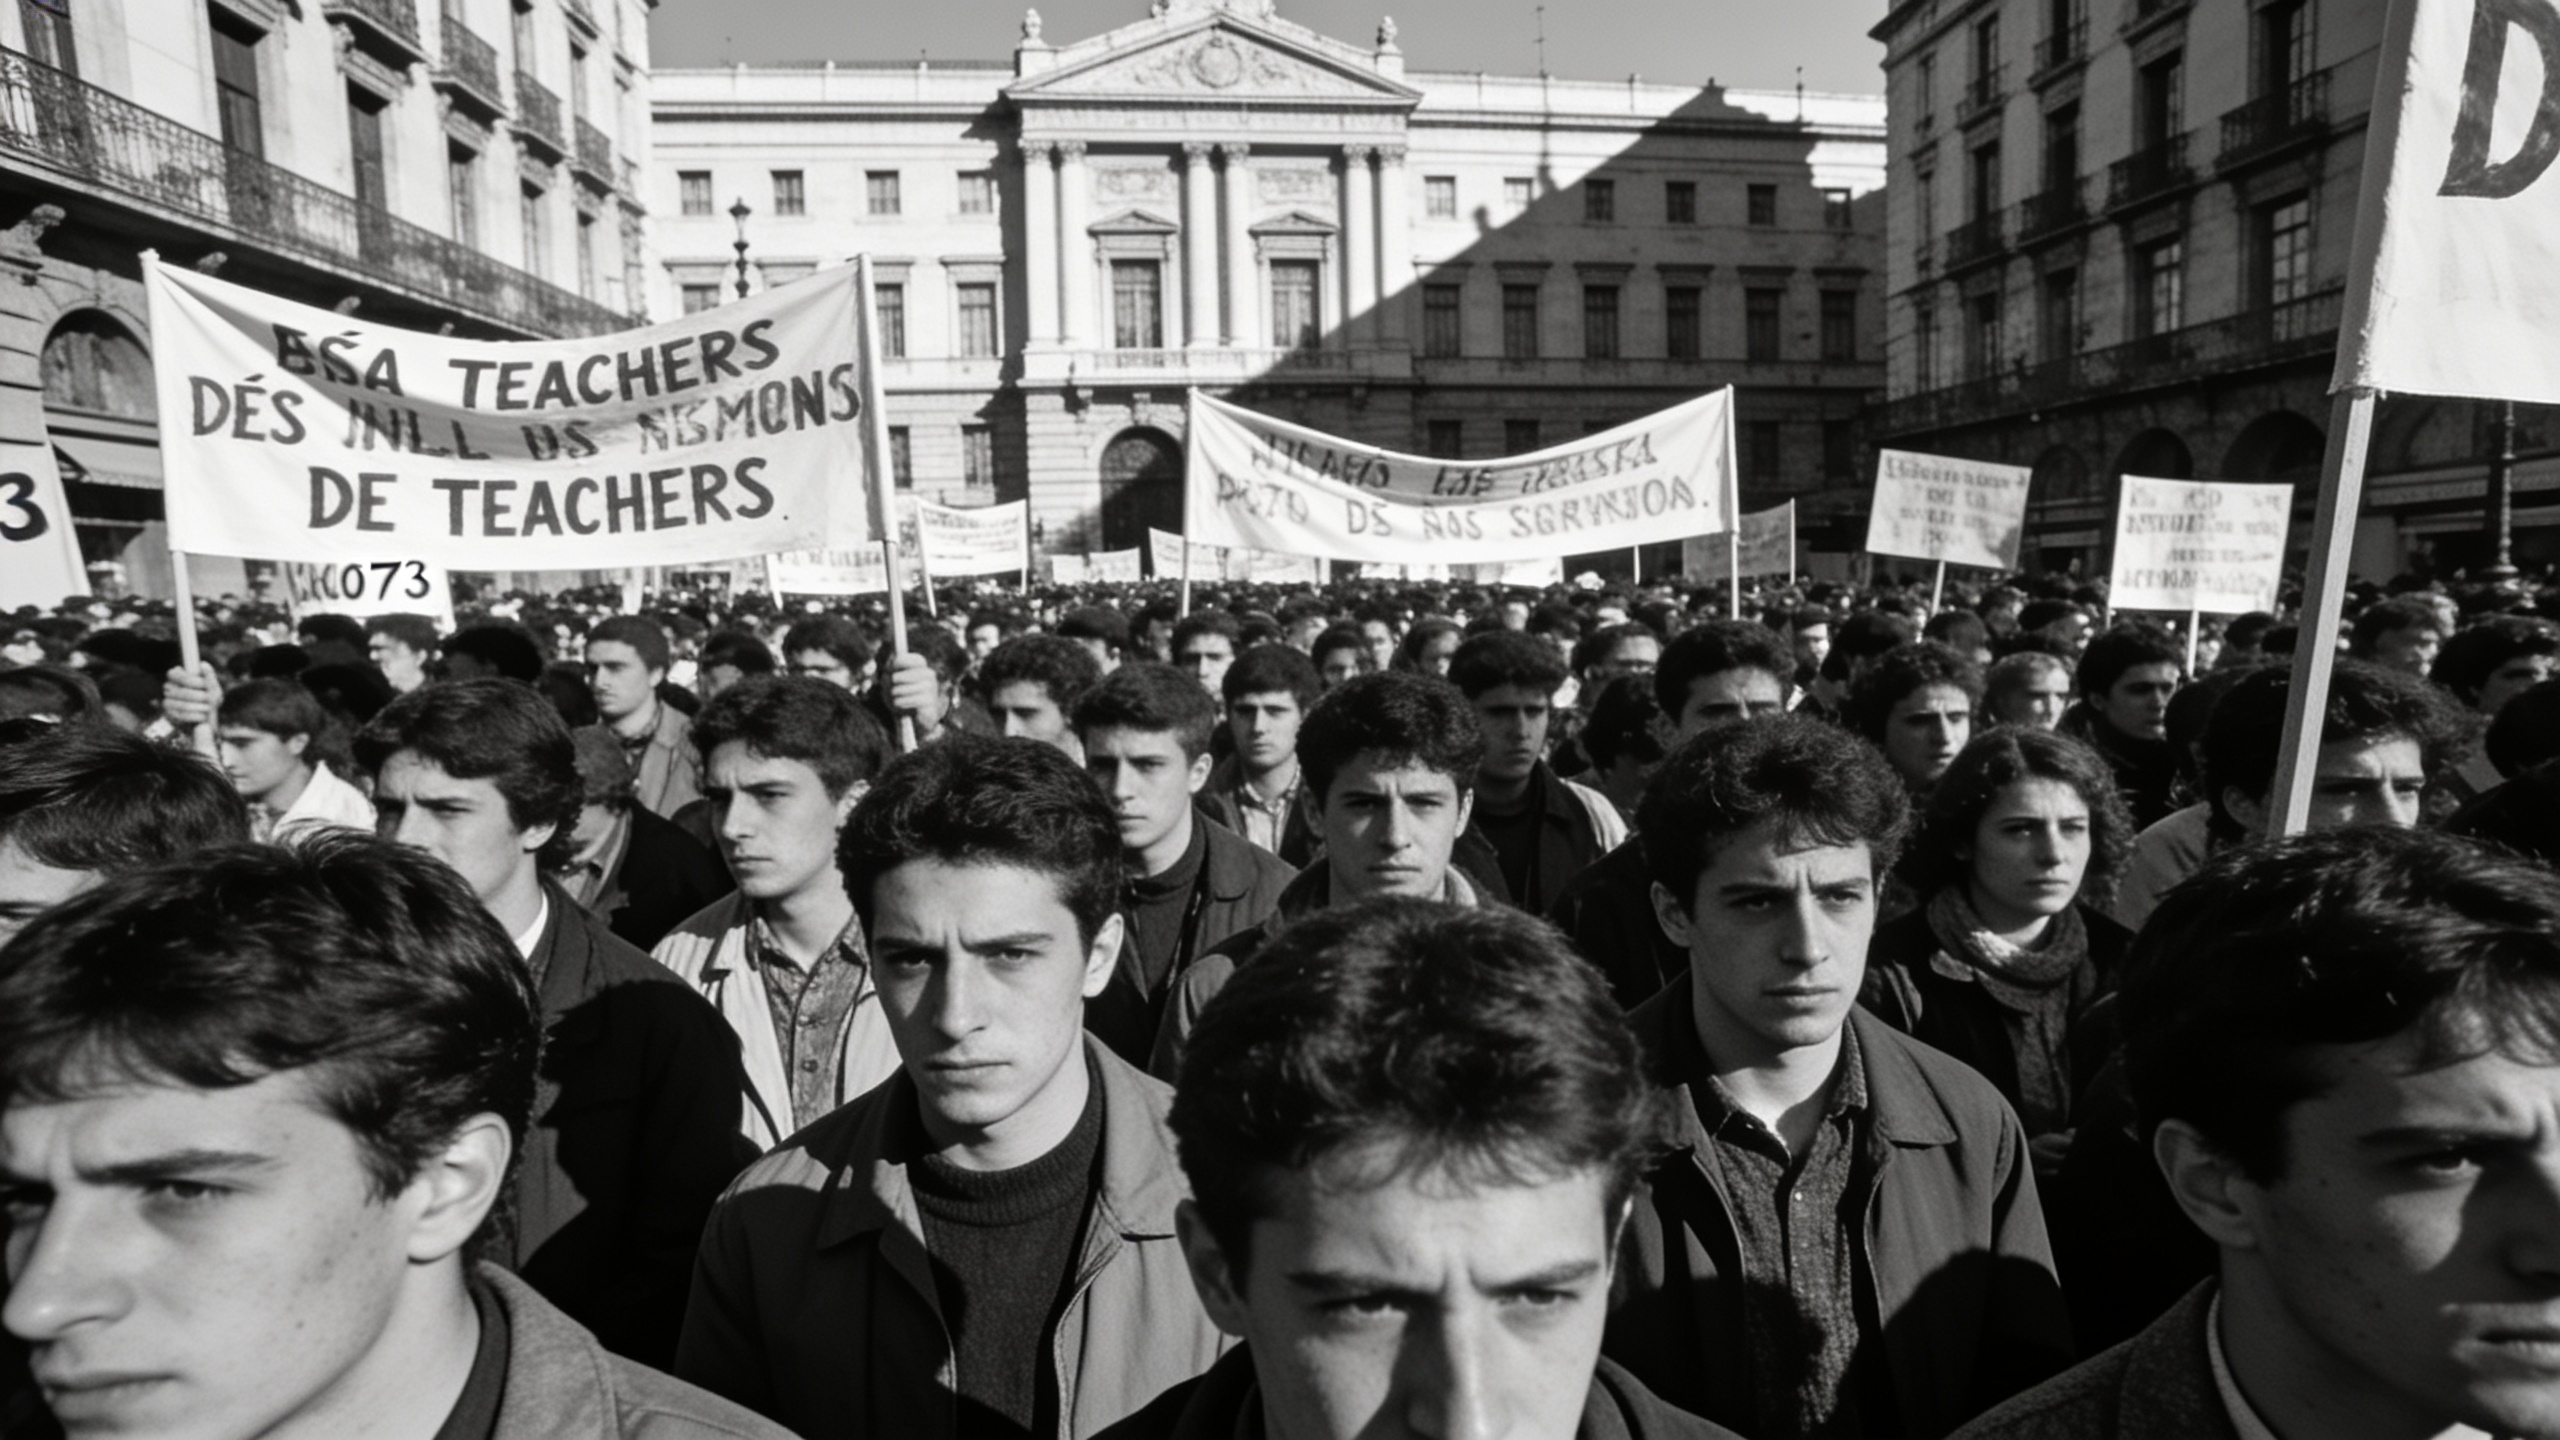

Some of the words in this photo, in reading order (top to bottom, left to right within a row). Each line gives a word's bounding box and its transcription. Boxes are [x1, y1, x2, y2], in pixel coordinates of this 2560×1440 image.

[448, 318, 780, 411] TEACHERS
[188, 373, 306, 445] DÉS
[0, 471, 49, 542] 3
[307, 465, 398, 532] DE
